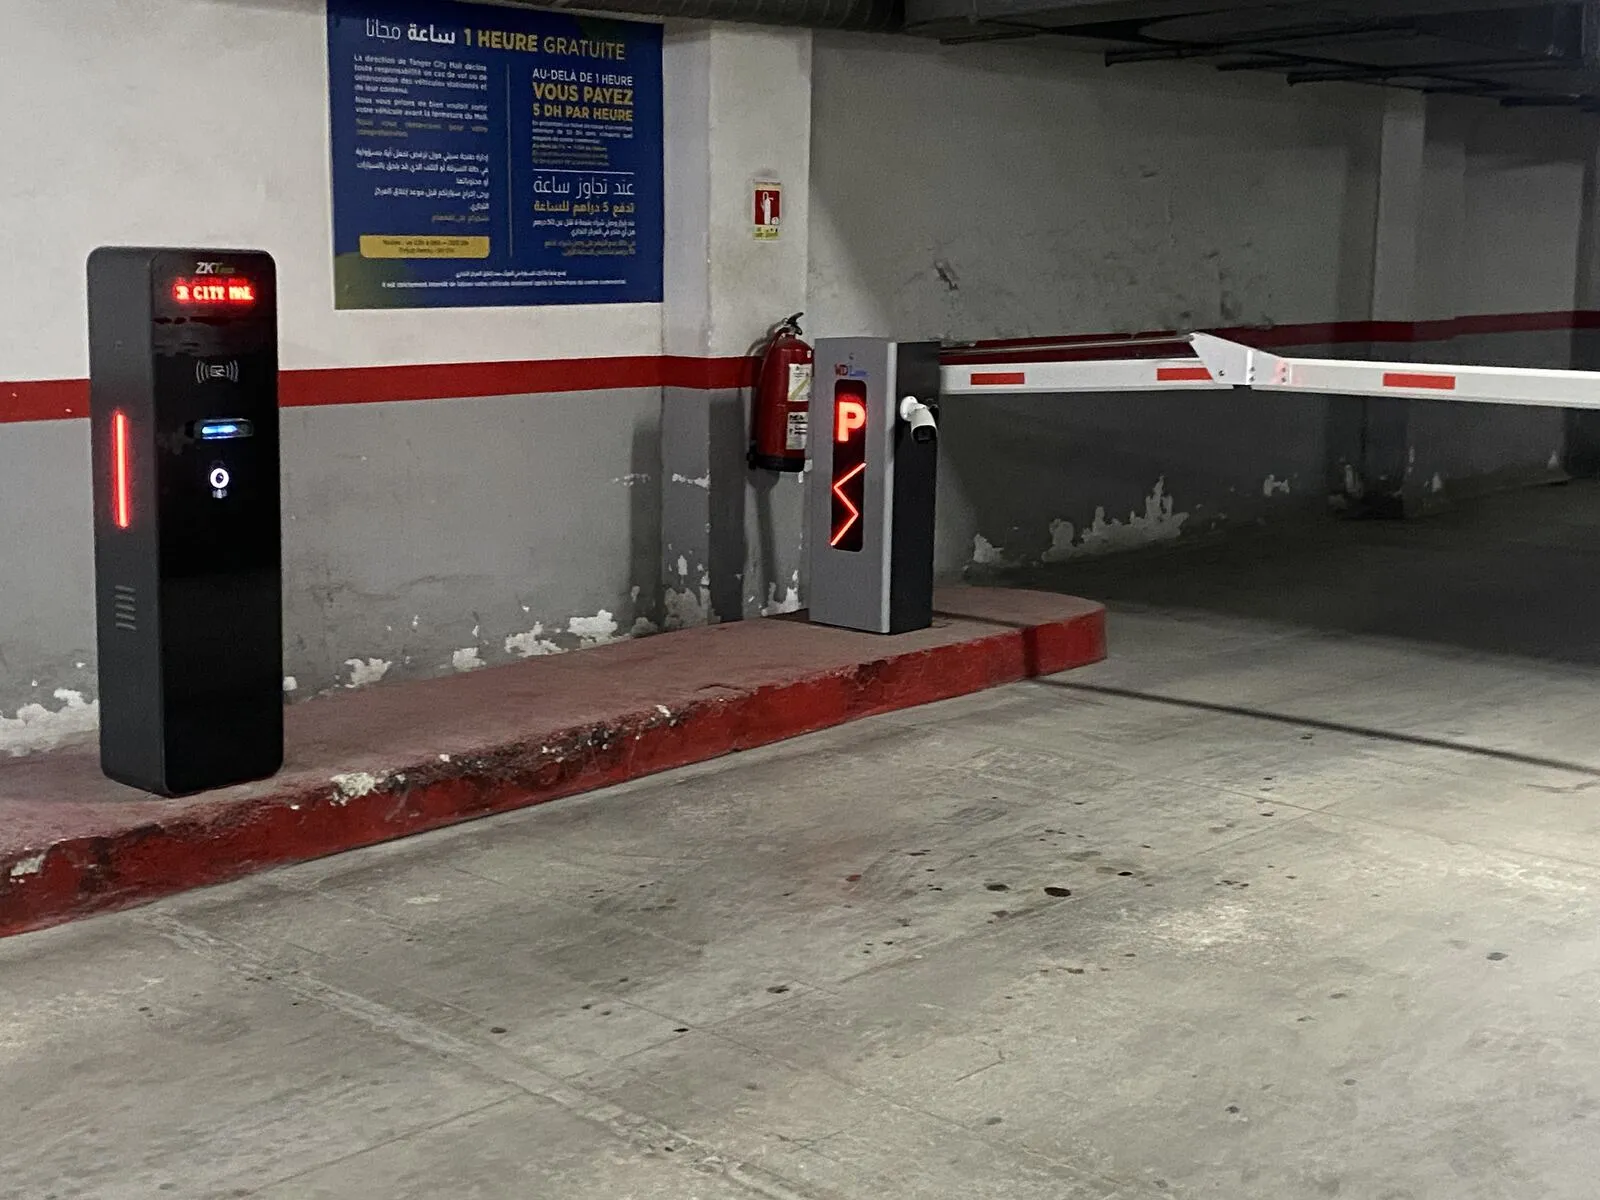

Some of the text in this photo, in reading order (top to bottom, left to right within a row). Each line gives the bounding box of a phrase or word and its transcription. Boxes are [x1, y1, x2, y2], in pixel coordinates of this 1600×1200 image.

[408, 24, 455, 44] ساعة
[464, 29, 625, 60] 1 HEURE GRATUITE
[580, 72, 592, 83] DE
[596, 74, 599, 83] 1
[602, 75, 633, 86] HEURE
[533, 82, 633, 105] VOUS PAYEZ
[533, 103, 633, 122] 5 DH PAR HEURE
[533, 176, 634, 199] عند تجاوز ساعة
[534, 200, 569, 211] للساعة
[603, 202, 609, 212] 5
[193, 286, 224, 300] CITY
[837, 401, 867, 442] P
